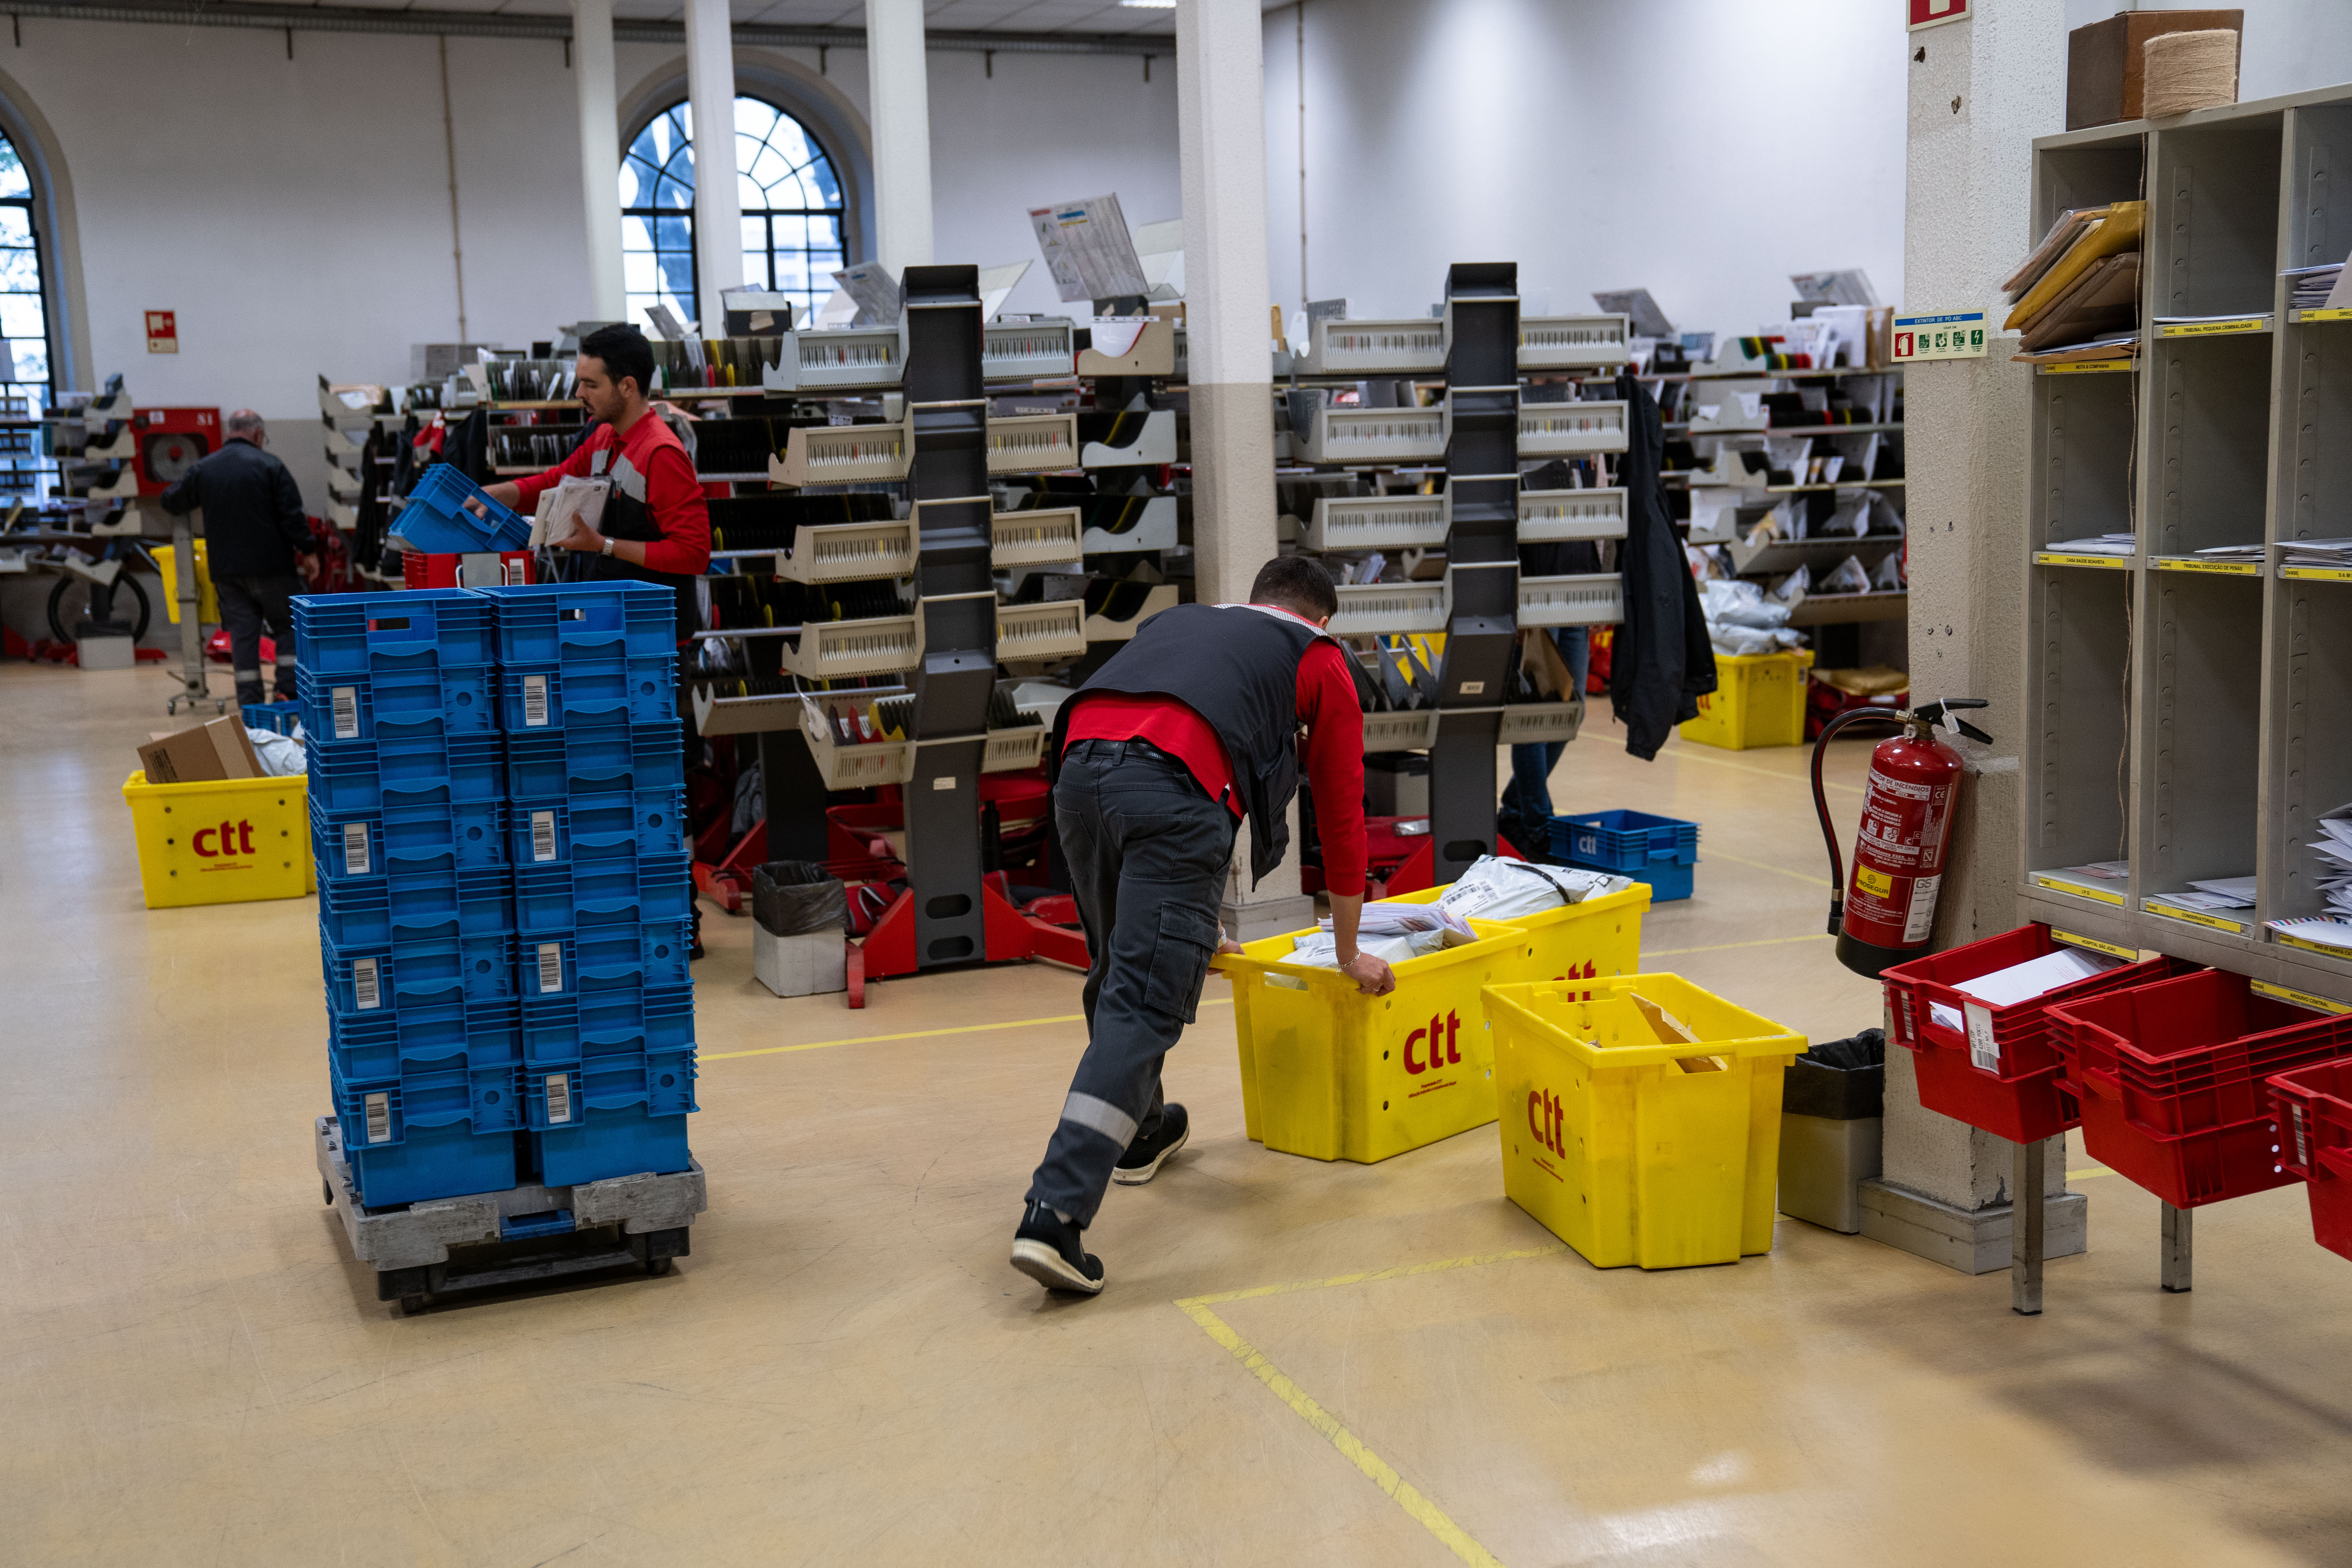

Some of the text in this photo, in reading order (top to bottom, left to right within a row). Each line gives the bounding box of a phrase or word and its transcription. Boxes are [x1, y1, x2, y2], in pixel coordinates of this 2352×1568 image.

[1895, 782, 1929, 792] INCÊNDIOS
[192, 818, 256, 857] ctt
[1857, 878, 1889, 895] PROSEGUR
[1916, 878, 1932, 888] GS
[2181, 913, 2215, 924] CONSERVATÓRIAS
[1552, 959, 1596, 1003] tt
[2290, 993, 2308, 1002] ARQUIVO
[2309, 998, 2329, 1007] CENTRAL
[1403, 1008, 1461, 1075] ctt
[1528, 1087, 1565, 1160] ctt
